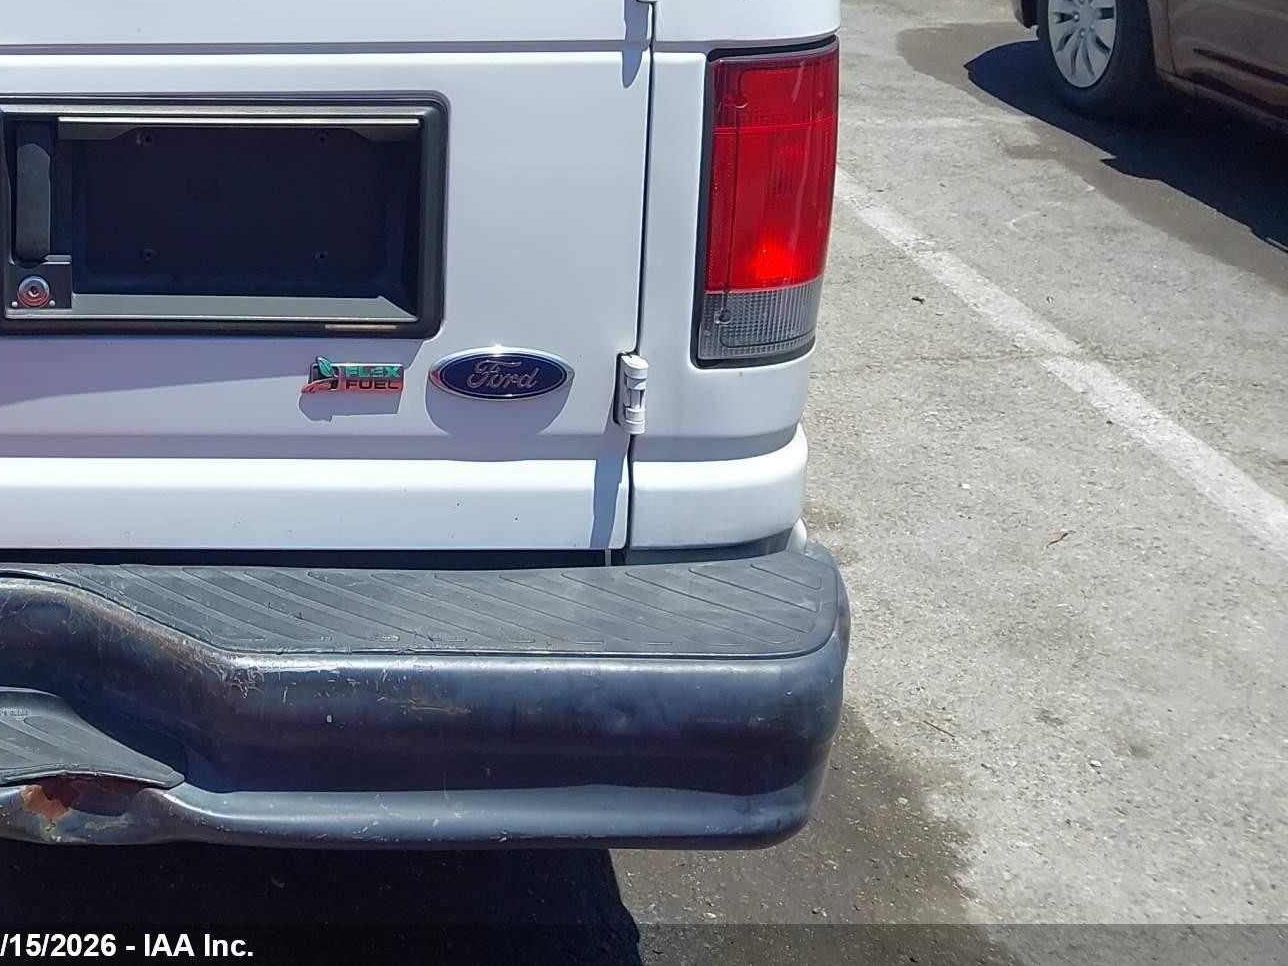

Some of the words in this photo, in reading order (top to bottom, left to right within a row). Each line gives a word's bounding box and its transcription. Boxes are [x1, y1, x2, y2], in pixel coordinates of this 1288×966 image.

[345, 366, 401, 378] FLEX
[466, 359, 540, 389] Ford
[345, 379, 400, 390] FUEL
